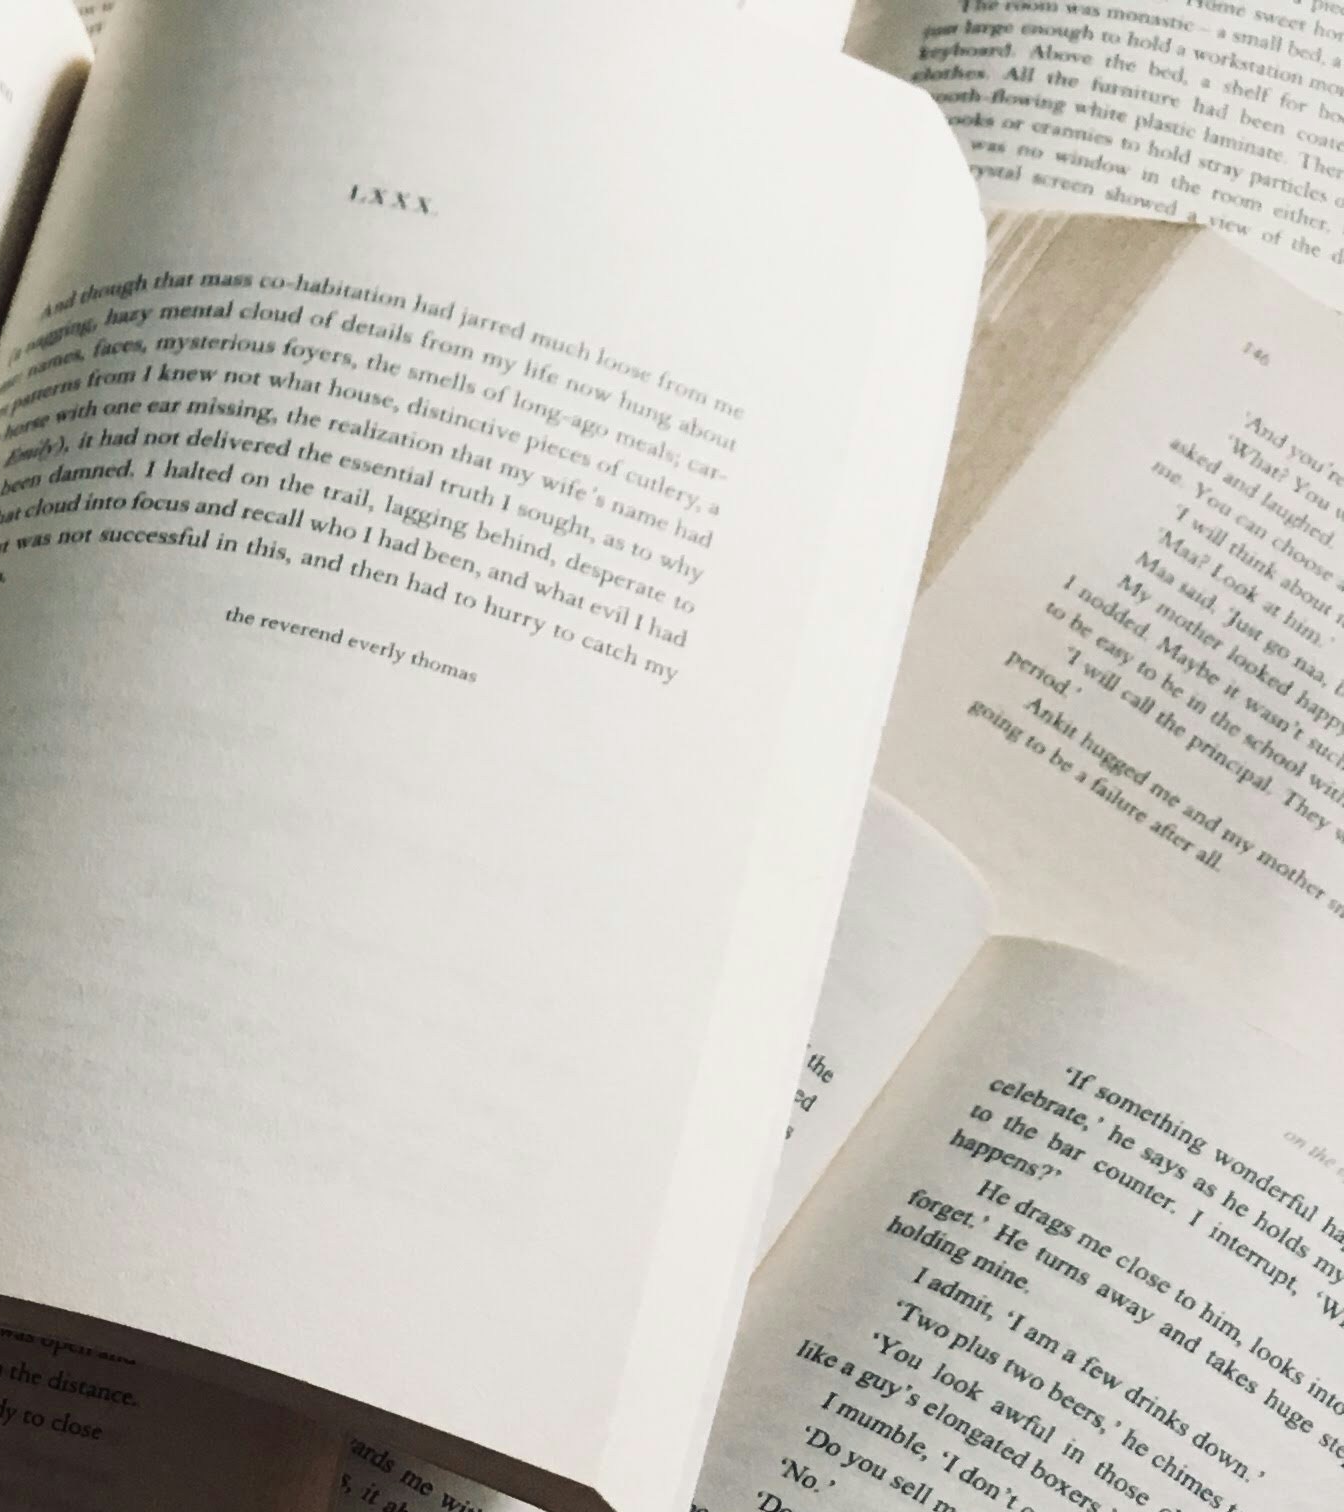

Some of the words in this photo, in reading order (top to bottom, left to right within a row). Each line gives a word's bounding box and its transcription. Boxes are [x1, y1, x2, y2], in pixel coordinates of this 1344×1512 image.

[224, 605, 255, 625] the
[259, 616, 344, 644] reverend
[346, 636, 406, 665] everly
[410, 649, 477, 682] thomas
[1024, 697, 1078, 739] Ankit
[1079, 730, 1152, 786] hugged
[1148, 782, 1181, 807] me
[1181, 805, 1223, 833] and
[1220, 827, 1255, 855] my
[1255, 849, 1326, 900] mother
[804, 1425, 841, 1457] ‘Do
[839, 1449, 887, 1481] you
[888, 1475, 934, 1505] sell
